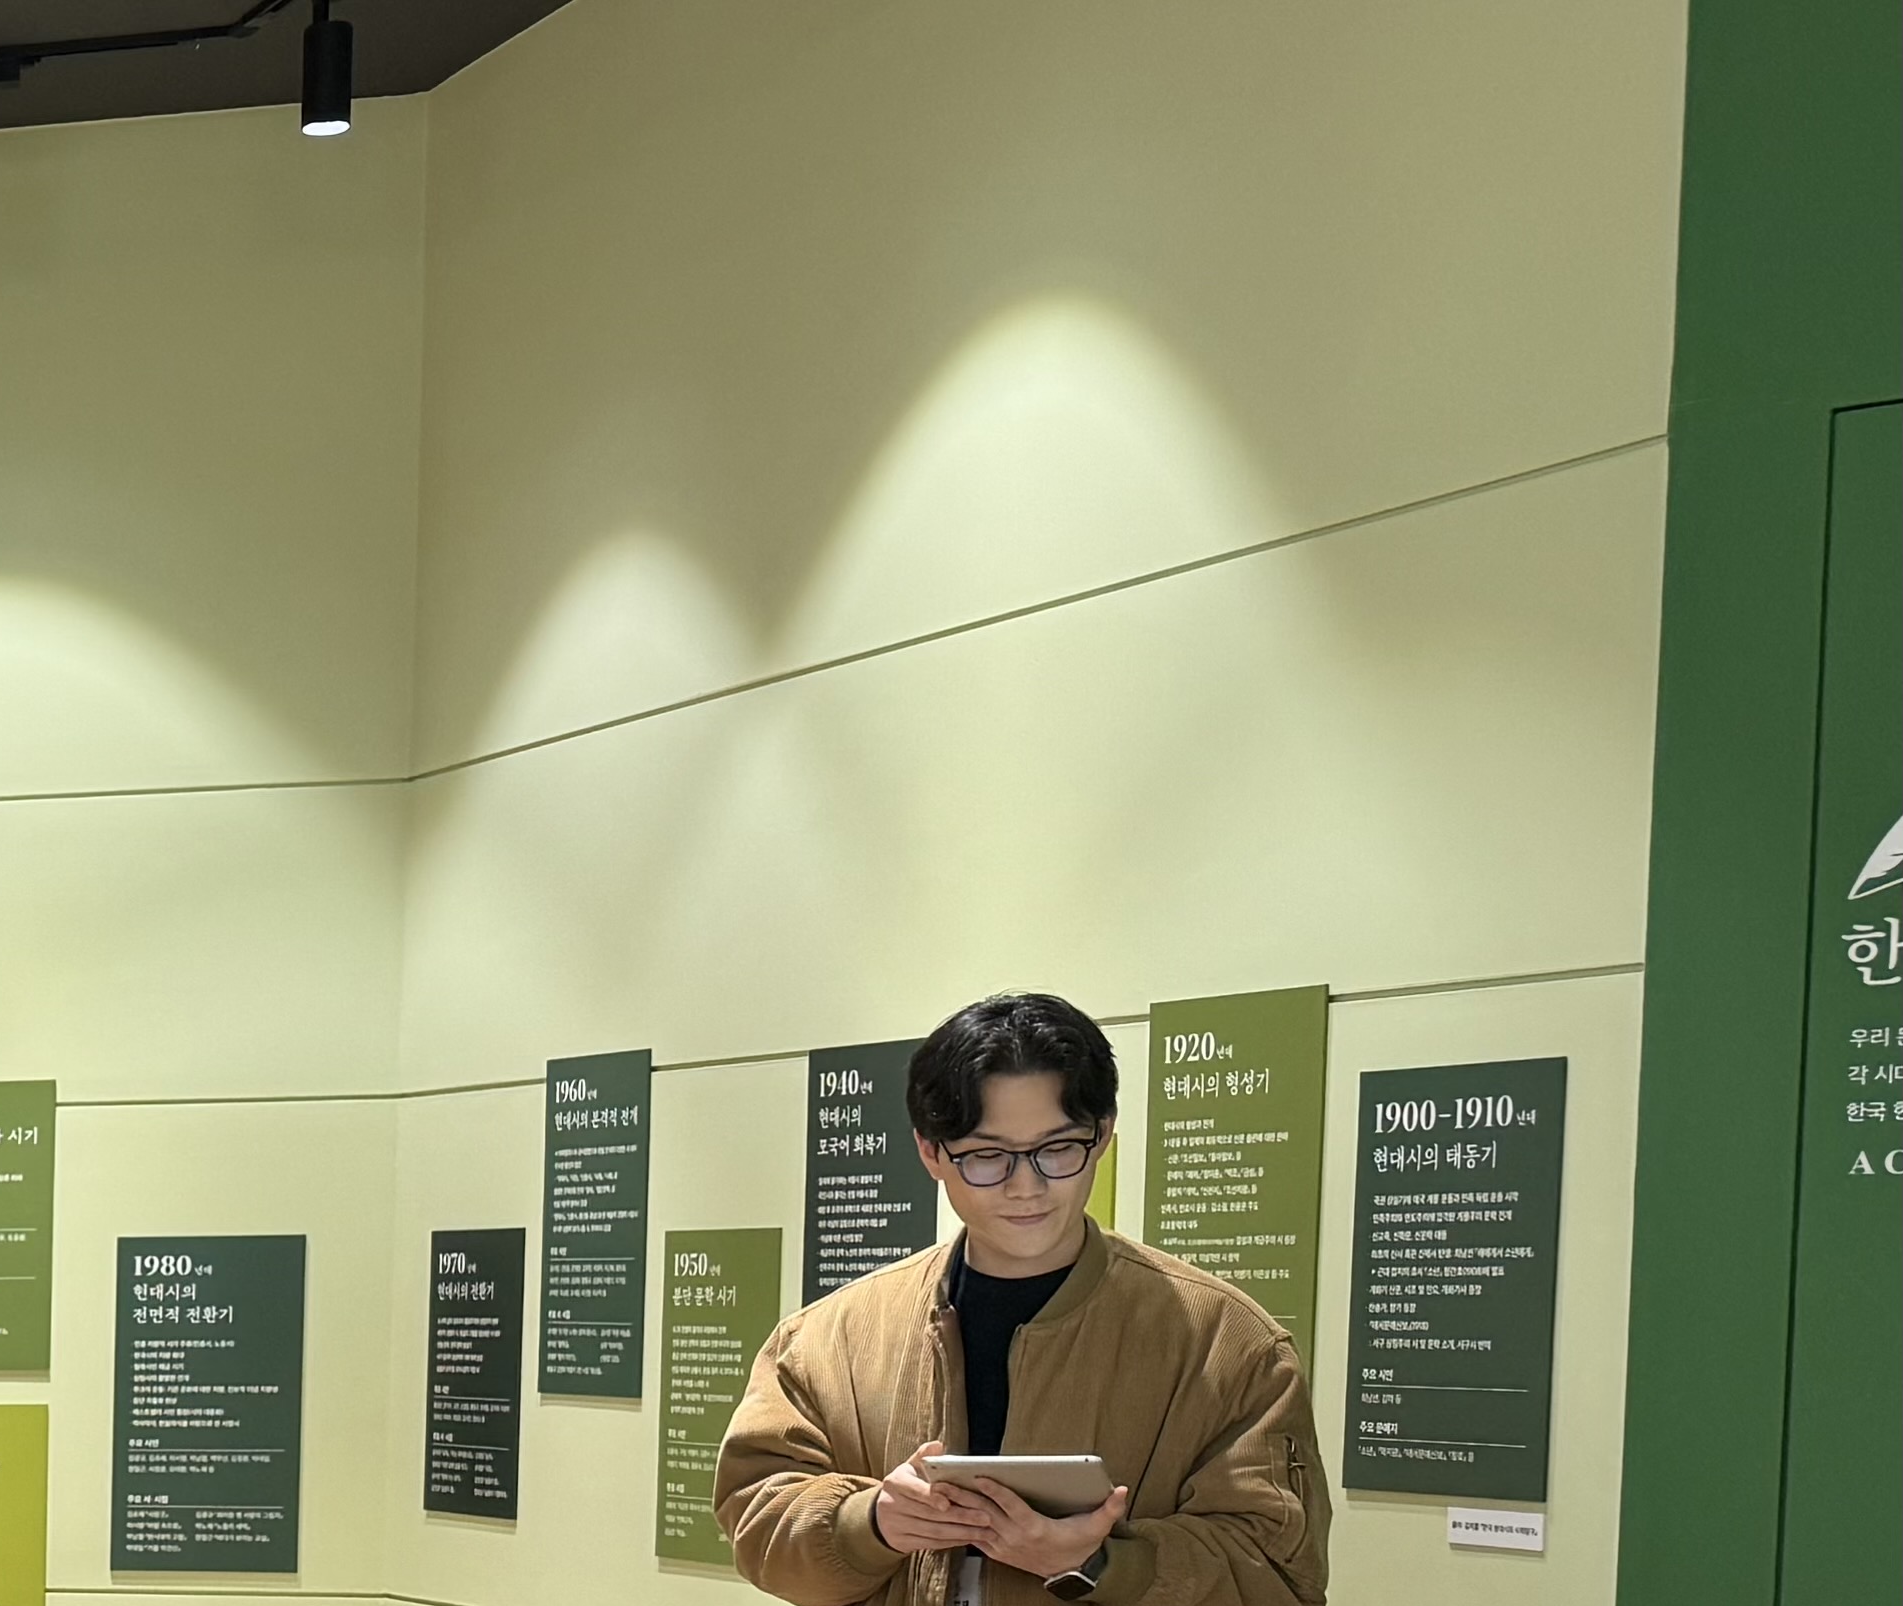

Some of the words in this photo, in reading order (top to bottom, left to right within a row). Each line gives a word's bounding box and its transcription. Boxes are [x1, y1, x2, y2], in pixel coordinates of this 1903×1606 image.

[1849, 1026, 1891, 1048] 우리
[1163, 1071, 1220, 1100] 현대시의
[1225, 1067, 1270, 1096] 형성기
[1847, 1065, 1870, 1086] 각
[1873, 1064, 1903, 1084] 시
[818, 1104, 862, 1129] 현대시의
[1846, 1102, 1887, 1122] 한국
[7, 1126, 39, 1146] 시기
[817, 1133, 850, 1158] 모국어
[853, 1131, 887, 1157] 회복기
[1372, 1143, 1439, 1173] 현대시의
[1445, 1140, 1497, 1170] 태동기
[1847, 1150, 1876, 1176] A
[132, 1283, 197, 1302] 현대시의
[716, 1285, 737, 1307] 시기
[186, 1305, 233, 1324] 전환기
